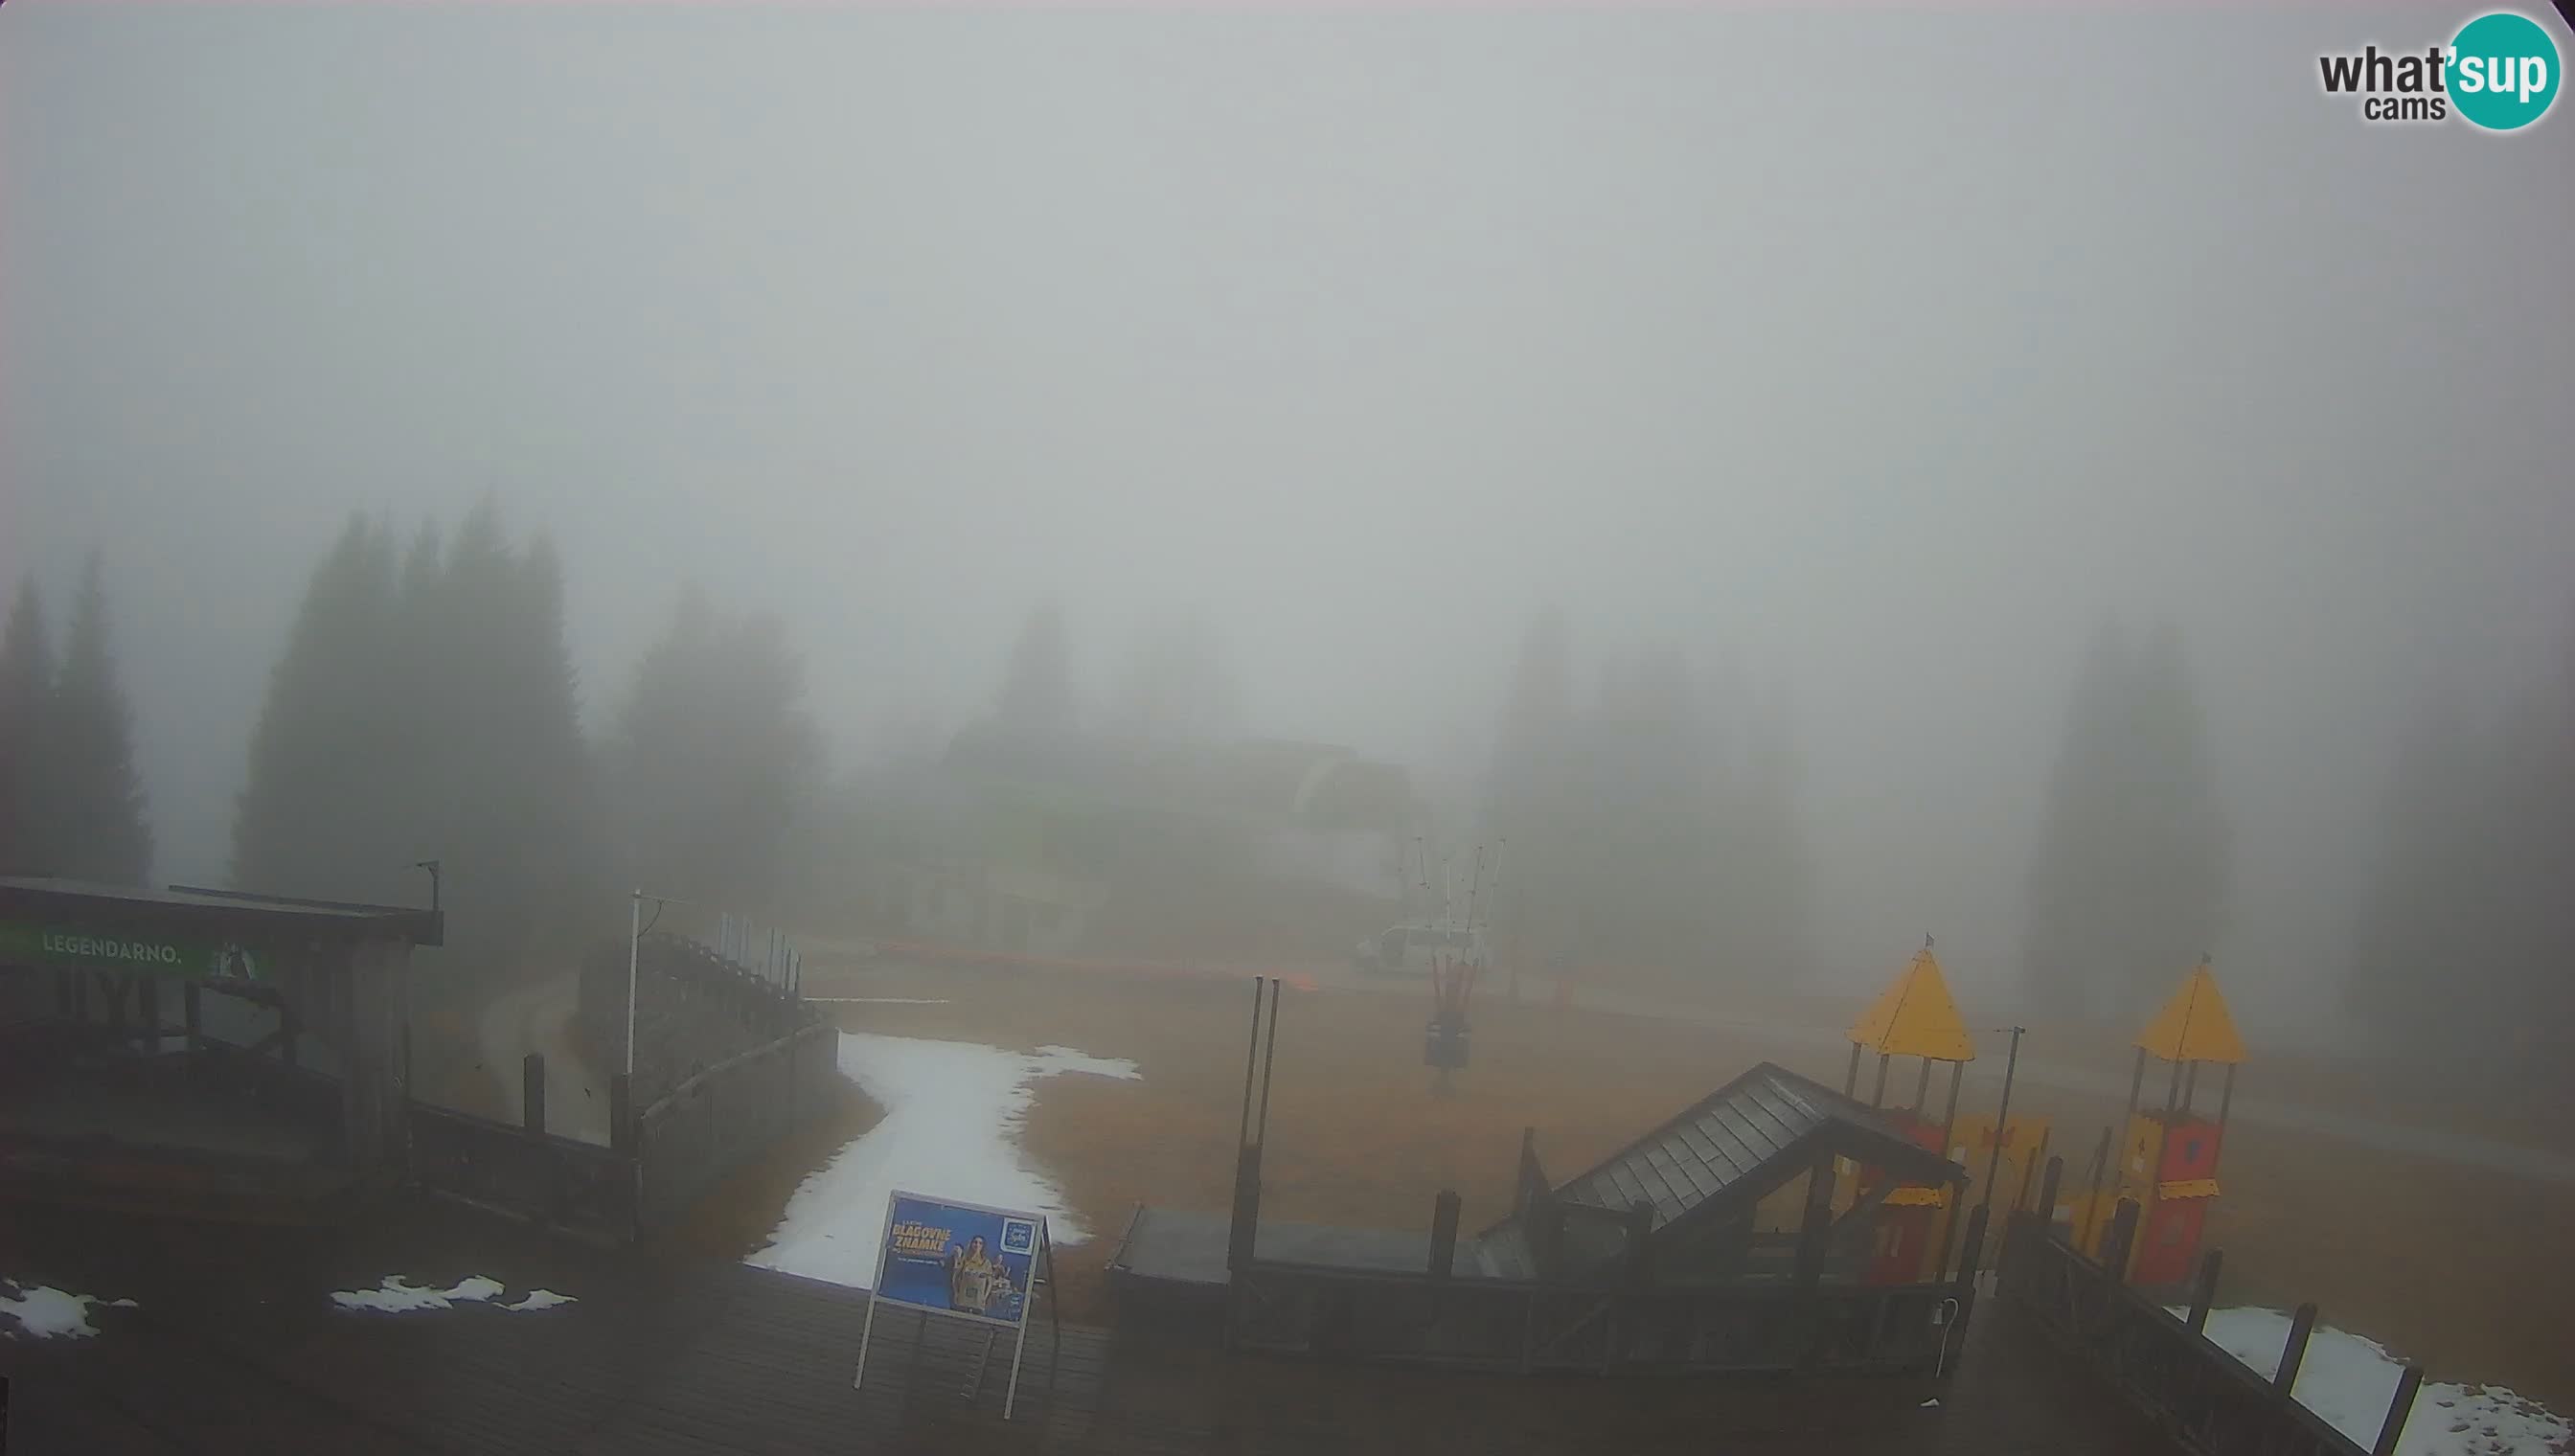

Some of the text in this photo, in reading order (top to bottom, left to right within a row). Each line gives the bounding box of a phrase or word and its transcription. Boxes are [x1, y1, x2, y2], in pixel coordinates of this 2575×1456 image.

[42, 933, 182, 965] LEGENDARNO.
[892, 1223, 952, 1241] BLAGOVNE
[894, 1235, 946, 1252] ZNAMKE
